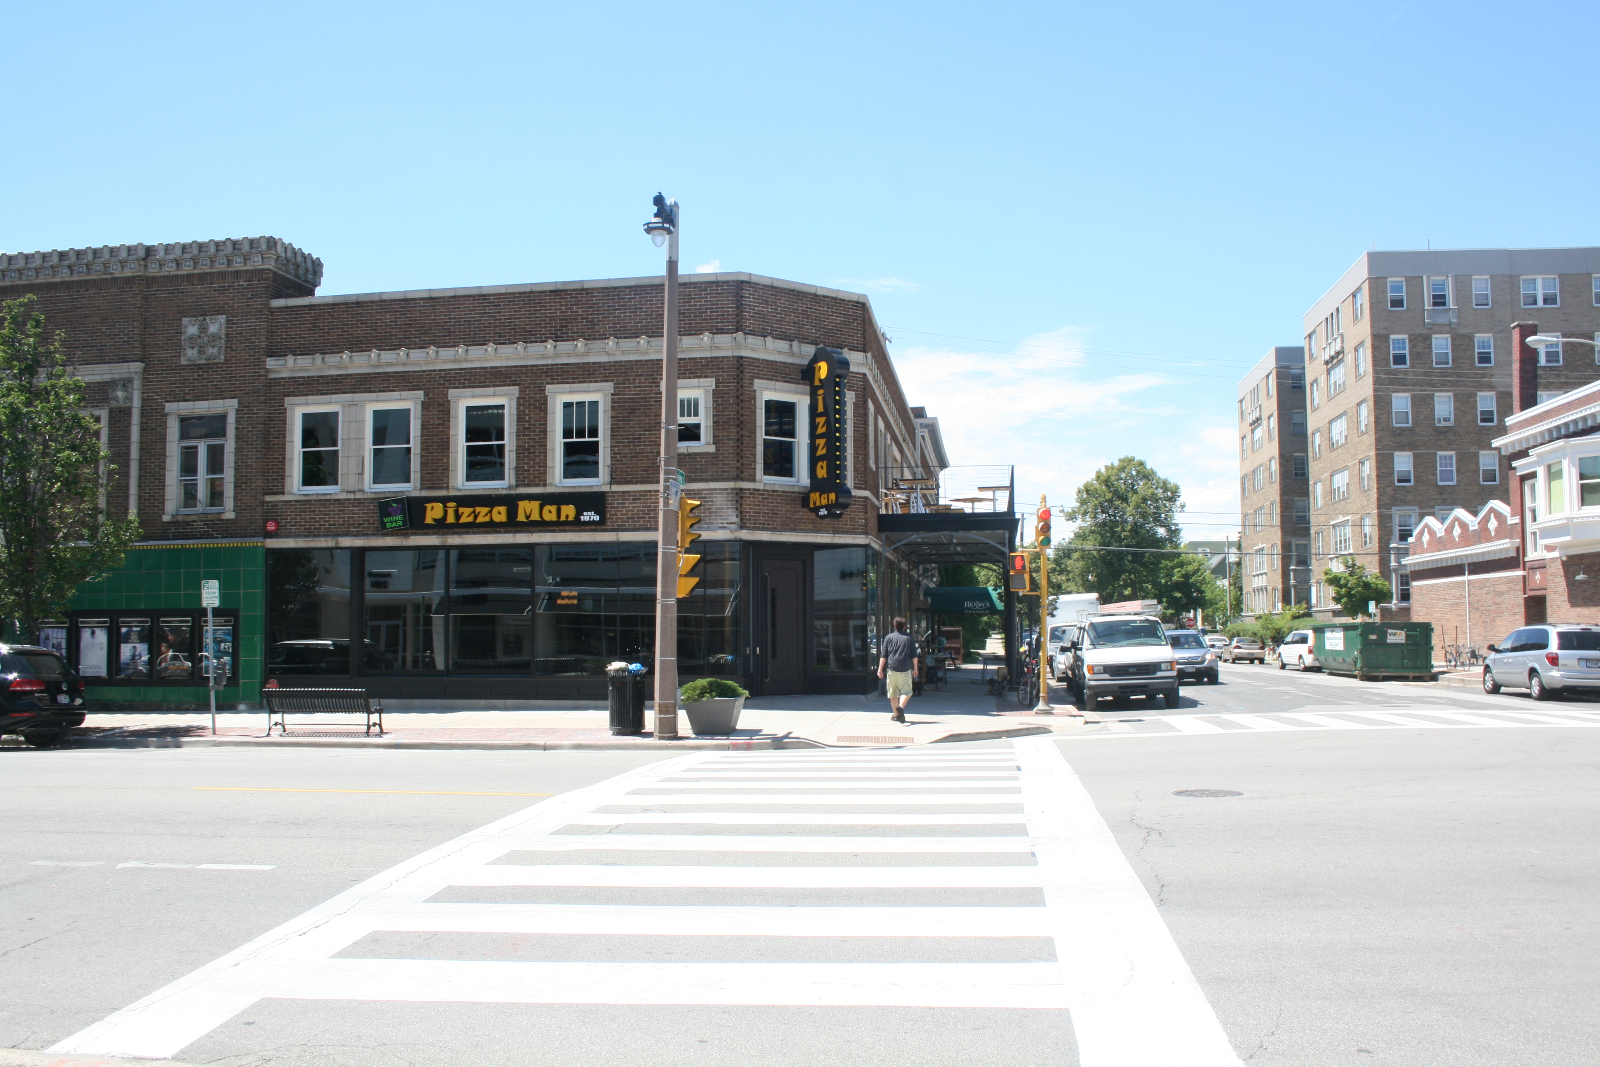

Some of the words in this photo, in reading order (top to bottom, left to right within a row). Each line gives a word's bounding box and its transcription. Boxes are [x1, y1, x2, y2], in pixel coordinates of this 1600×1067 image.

[813, 361, 828, 479] Pizza
[809, 491, 836, 508] Man
[383, 514, 404, 523] WINE
[423, 502, 508, 524] Pizza
[515, 500, 577, 522] Man
[386, 520, 403, 528] BAR
